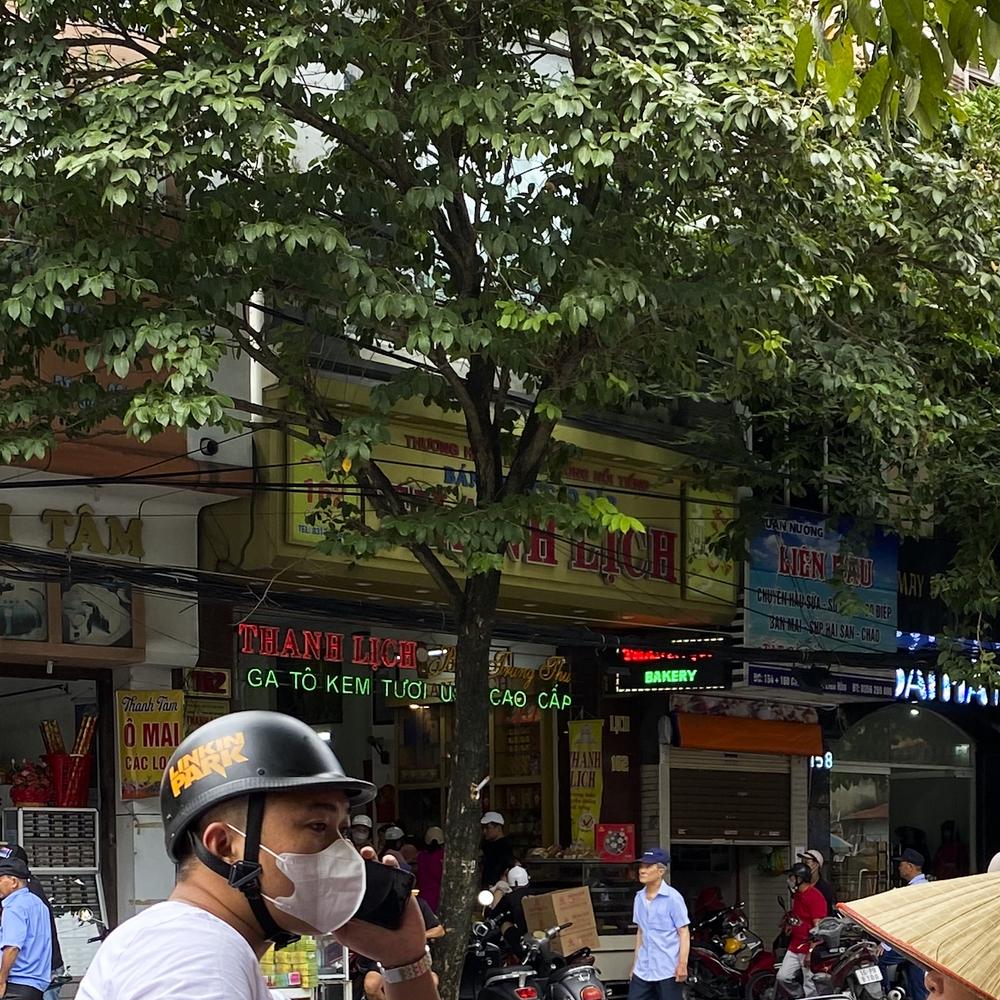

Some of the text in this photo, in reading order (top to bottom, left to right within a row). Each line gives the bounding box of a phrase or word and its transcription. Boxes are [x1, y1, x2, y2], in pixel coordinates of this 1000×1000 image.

[40, 503, 145, 557] TÂM
[778, 545, 826, 581] LIÊN
[238, 623, 344, 662] THANH
[352, 635, 417, 671] LỊCH
[247, 668, 279, 688] GA
[289, 667, 317, 691] TÔ
[326, 674, 370, 695] KEM
[489, 688, 527, 708] CAO
[538, 684, 572, 710] CẤP
[644, 669, 698, 684] BAKERY
[123, 718, 180, 748] Ô MAI
[168, 731, 246, 779] LINKIN
[171, 747, 249, 798] PARK
